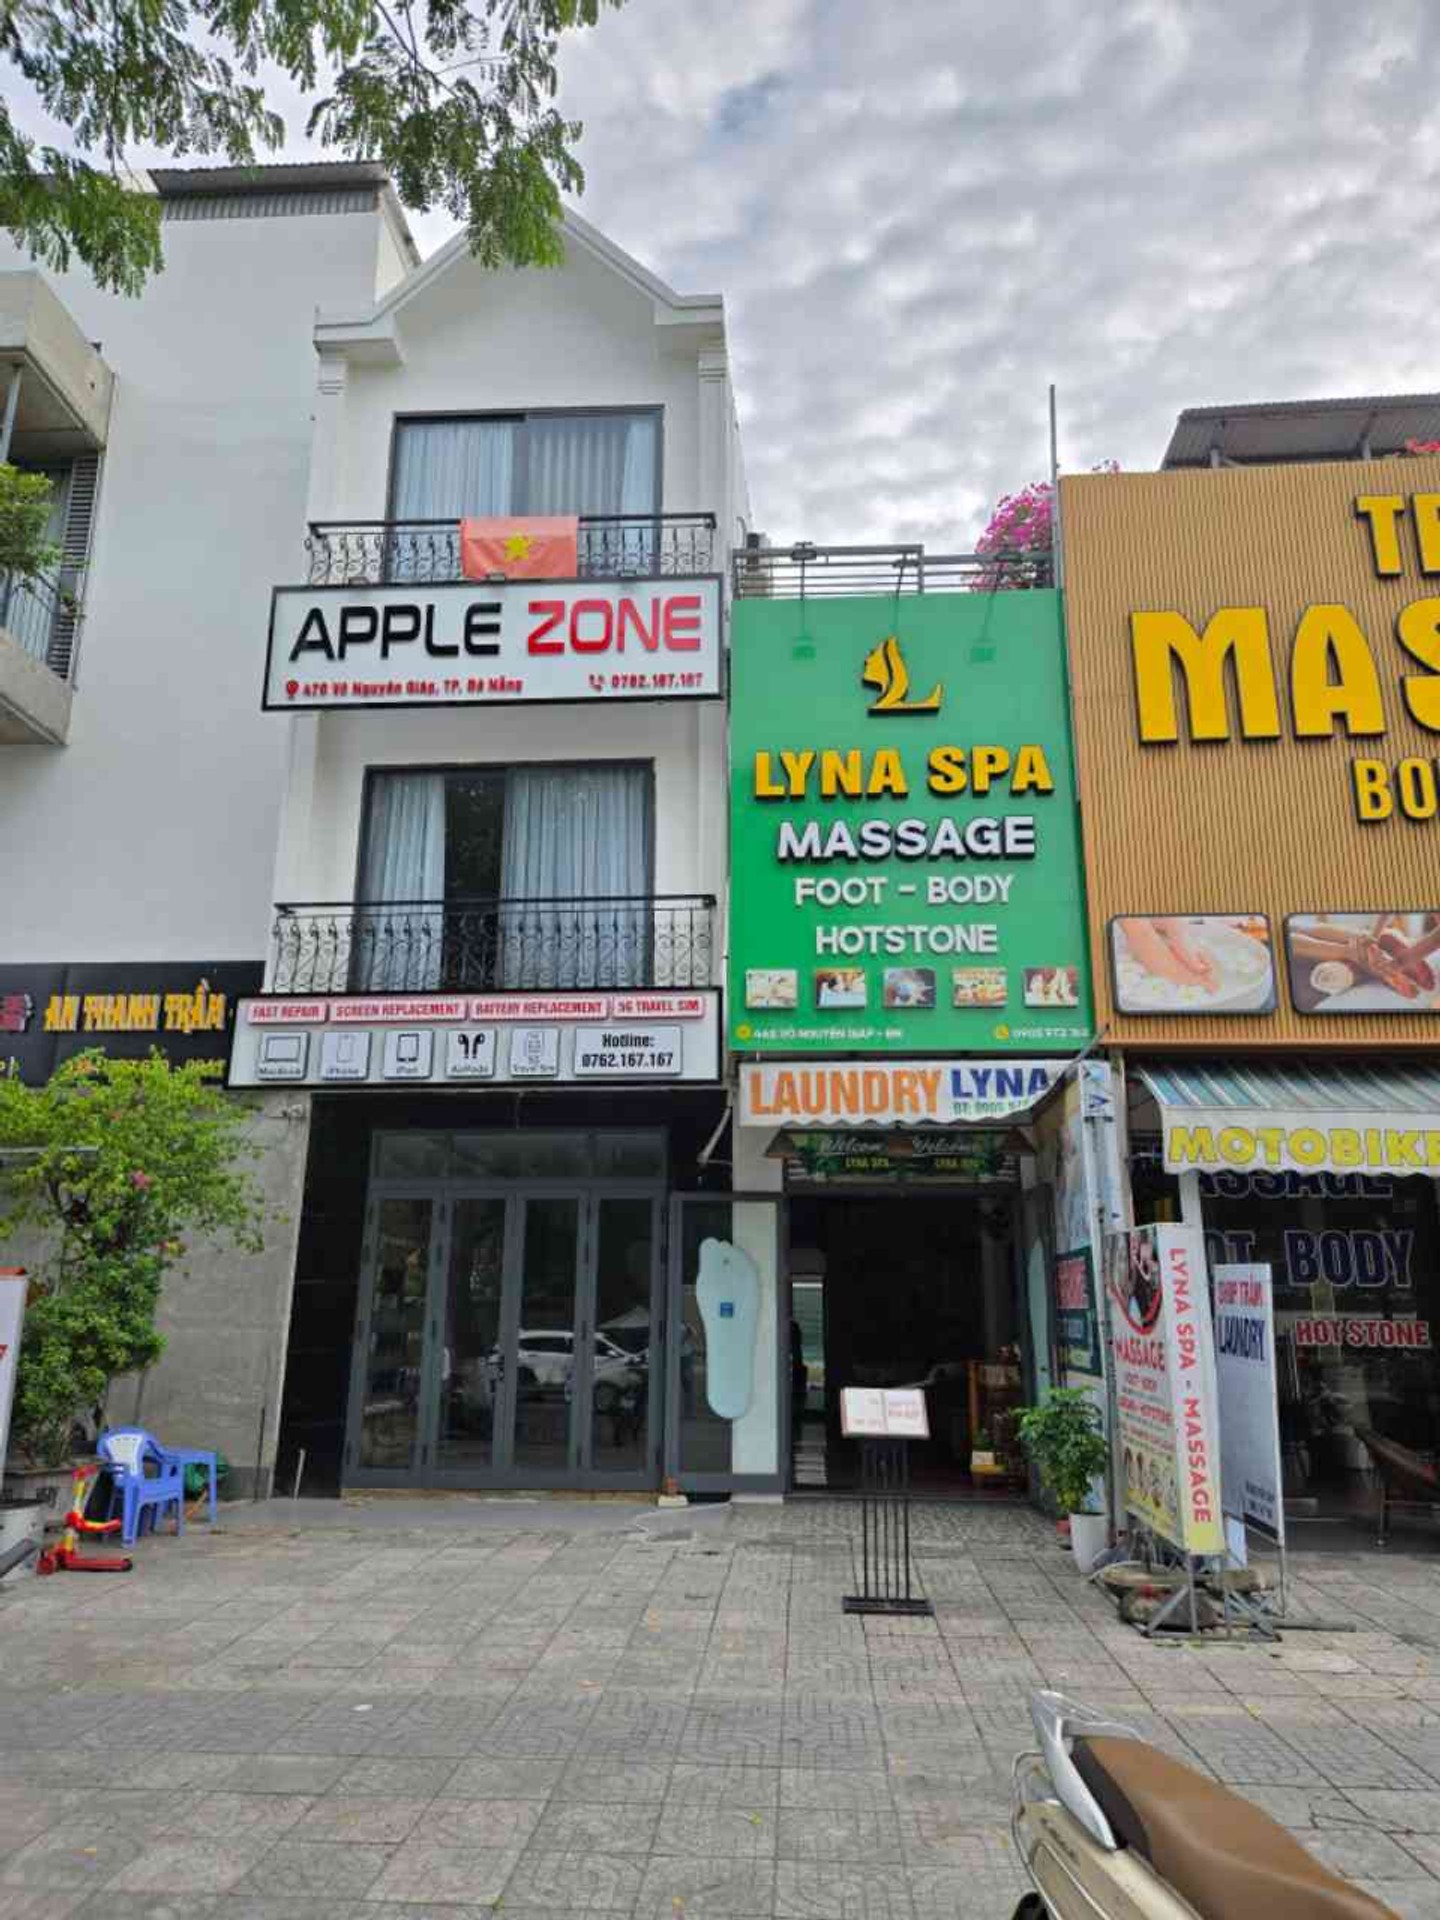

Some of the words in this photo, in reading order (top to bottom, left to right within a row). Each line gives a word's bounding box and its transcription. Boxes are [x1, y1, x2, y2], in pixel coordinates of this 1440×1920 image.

[289, 602, 502, 662] APPLE
[527, 596, 702, 656] ZONE
[754, 748, 908, 799] LYNA
[928, 744, 1054, 796] SPA
[777, 815, 1035, 863] MASSAGE
[794, 876, 887, 906] FOOT
[927, 874, 1015, 905] BODY
[816, 923, 998, 956] HOTSTONE
[253, 1006, 277, 1017] FAST
[281, 1006, 319, 1017] REPAIR
[336, 1005, 379, 1017] SCREEN
[382, 1003, 458, 1016] REPLACEMENT
[476, 1002, 520, 1014] BATTERY
[523, 1001, 601, 1014] REPLACEMENT
[637, 1000, 673, 1011] TRAVEL
[678, 1000, 699, 1011] SIM
[602, 1034, 655, 1048] Hotline:
[582, 1053, 673, 1068] 0762.167.167
[750, 1069, 942, 1116] LAUNDRY
[951, 1068, 1050, 1098] LYNA
[1284, 1229, 1415, 1288] BODY
[1169, 1248, 1192, 1314] LYNA
[1176, 1323, 1196, 1369] SPA
[1296, 1320, 1346, 1346] HOT
[1348, 1321, 1430, 1347] STONE
[1184, 1399, 1211, 1522] MASSAGE
